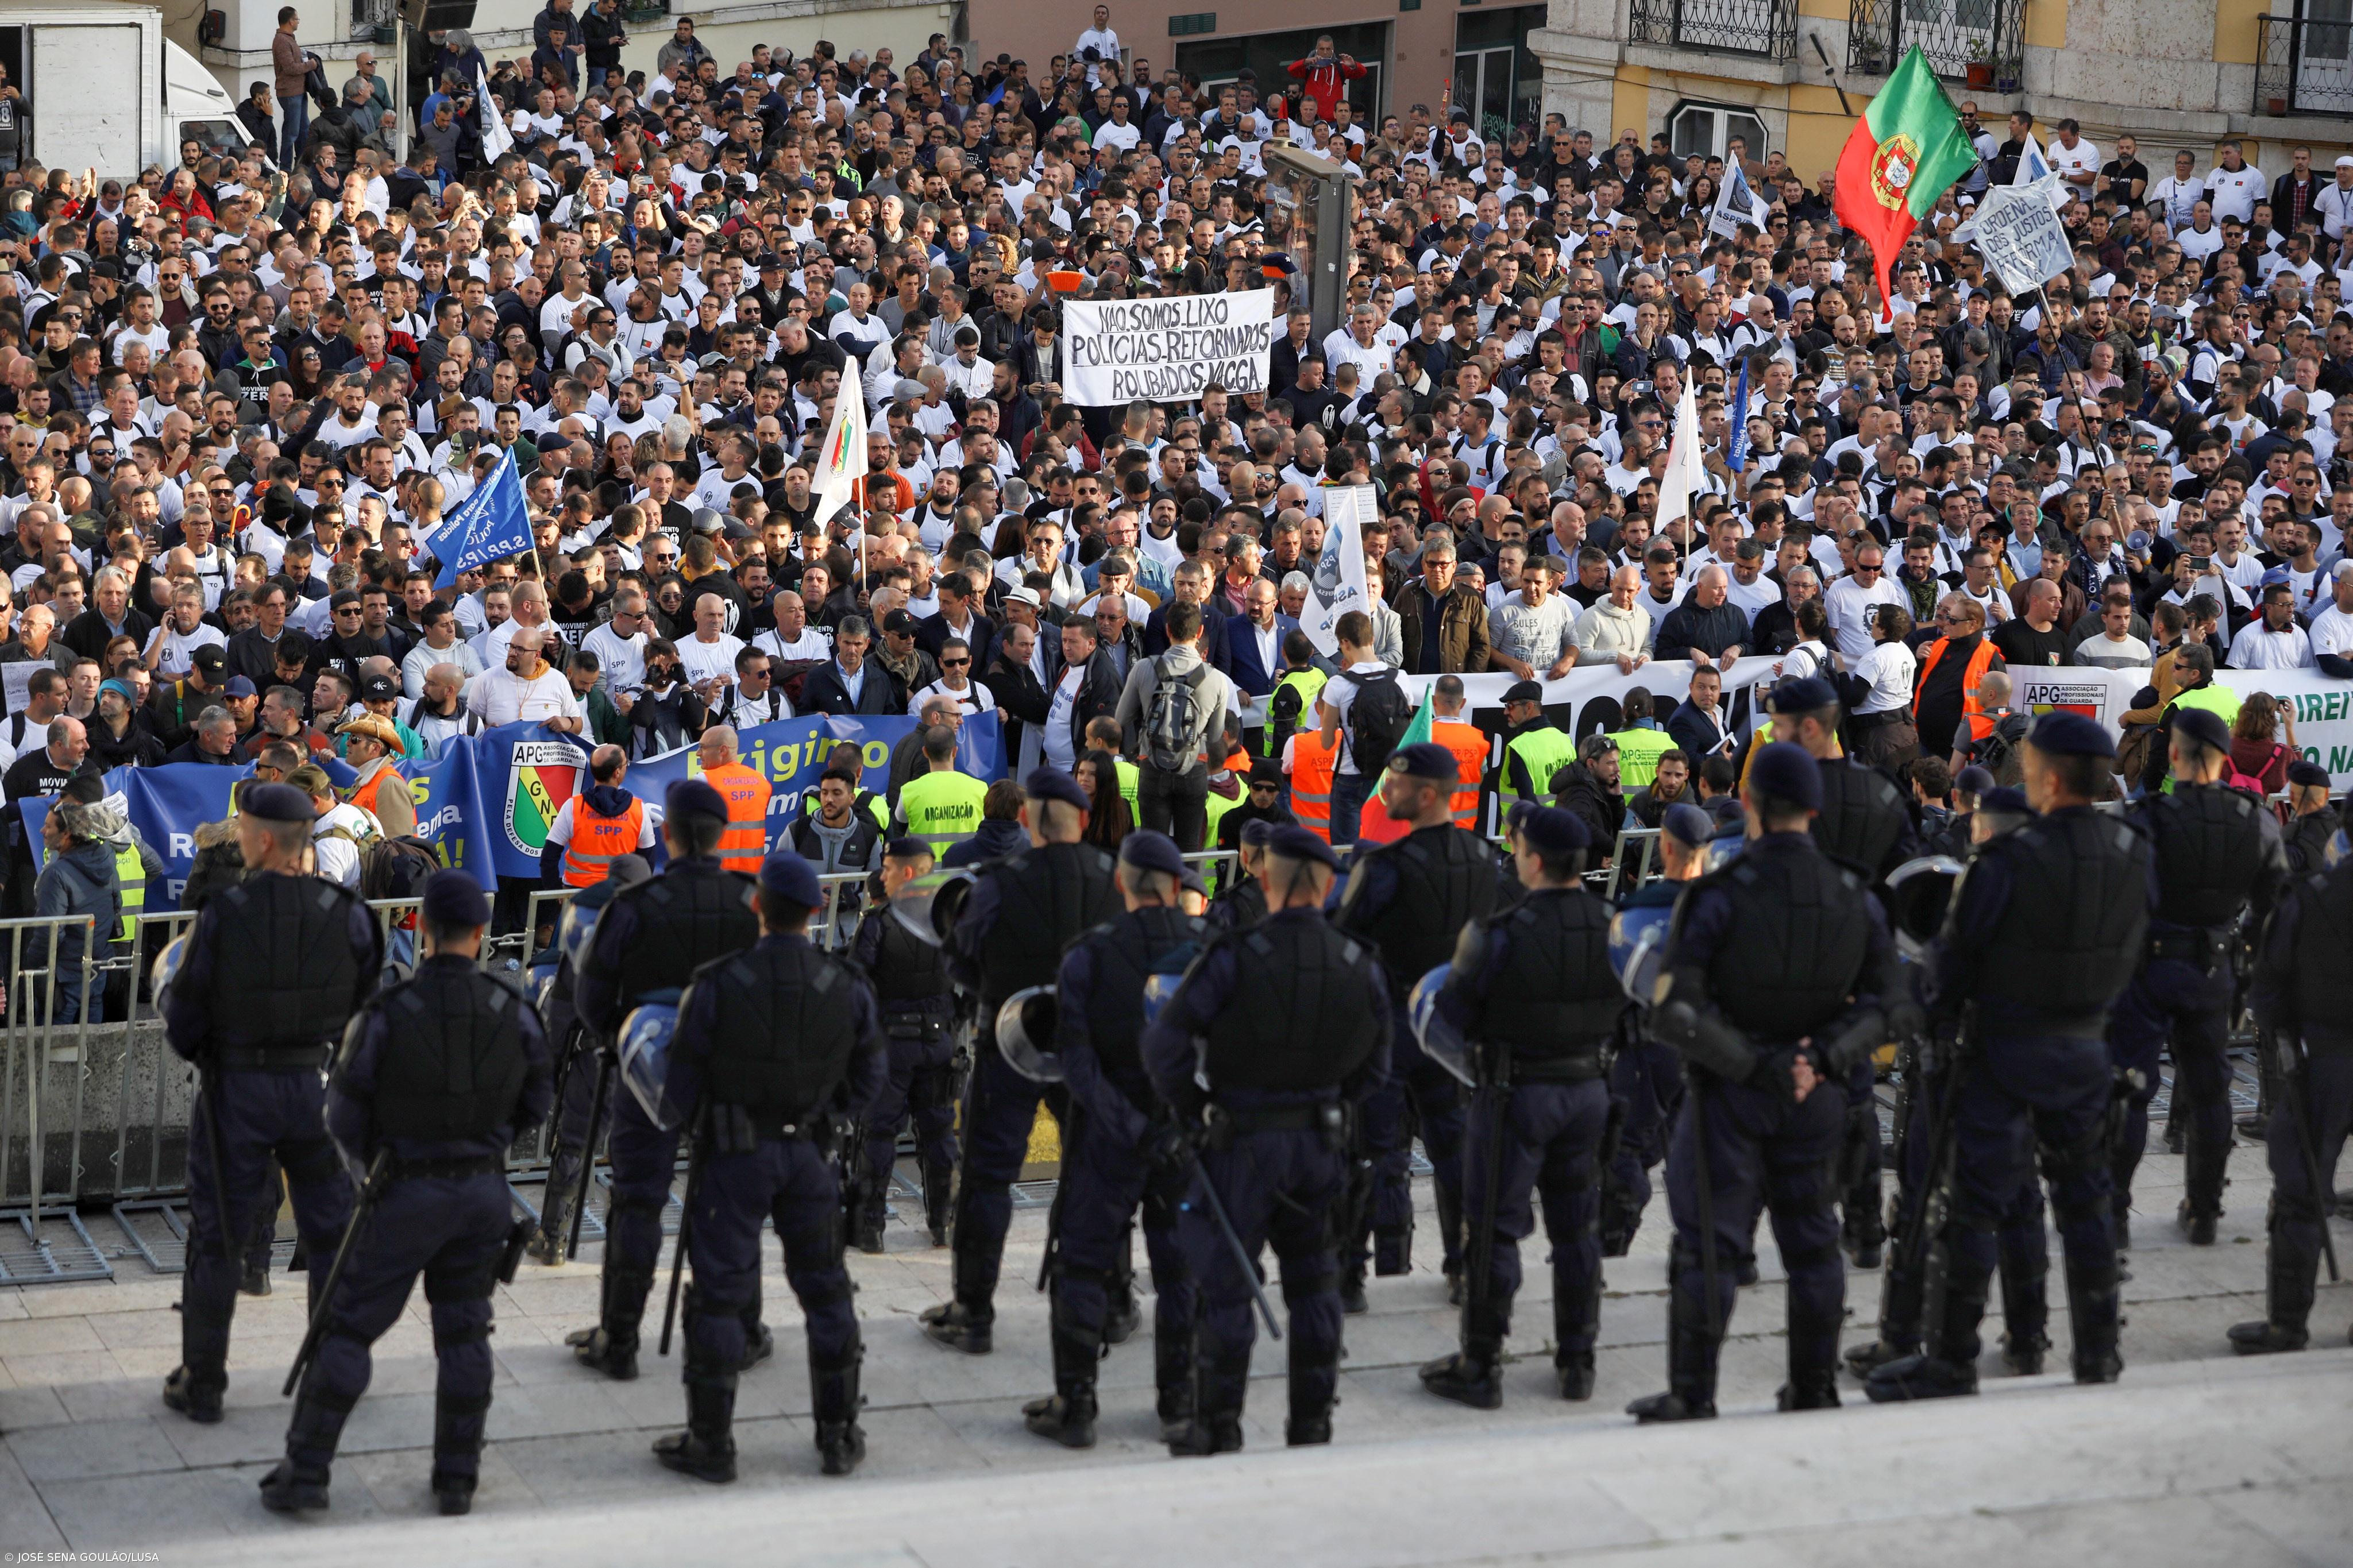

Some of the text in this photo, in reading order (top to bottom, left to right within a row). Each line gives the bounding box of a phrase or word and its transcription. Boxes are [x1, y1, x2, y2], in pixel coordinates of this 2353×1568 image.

[1985, 206, 2053, 253] DOS JUSTOS
[1996, 230, 2059, 276] REFORMA
[1167, 322, 1270, 362] REFORMADOS
[241, 392, 268, 401] ZER
[1514, 619, 1538, 628] RULES
[1515, 654, 1533, 663] NEW
[611, 660, 626, 669] SPP
[691, 669, 705, 677] SPP
[2027, 686, 2060, 703] APG
[514, 745, 543, 763] APG
[543, 745, 579, 754] ASSOCIAÇÃO
[1621, 749, 1641, 761] APG
[543, 751, 585, 761] PROFISSIONAIS
[731, 791, 755, 801] SPP
[504, 799, 514, 820] PELA
[416, 805, 462, 839] ema
[595, 825, 623, 836] SPP
[506, 822, 539, 855] DEFESA DOS
